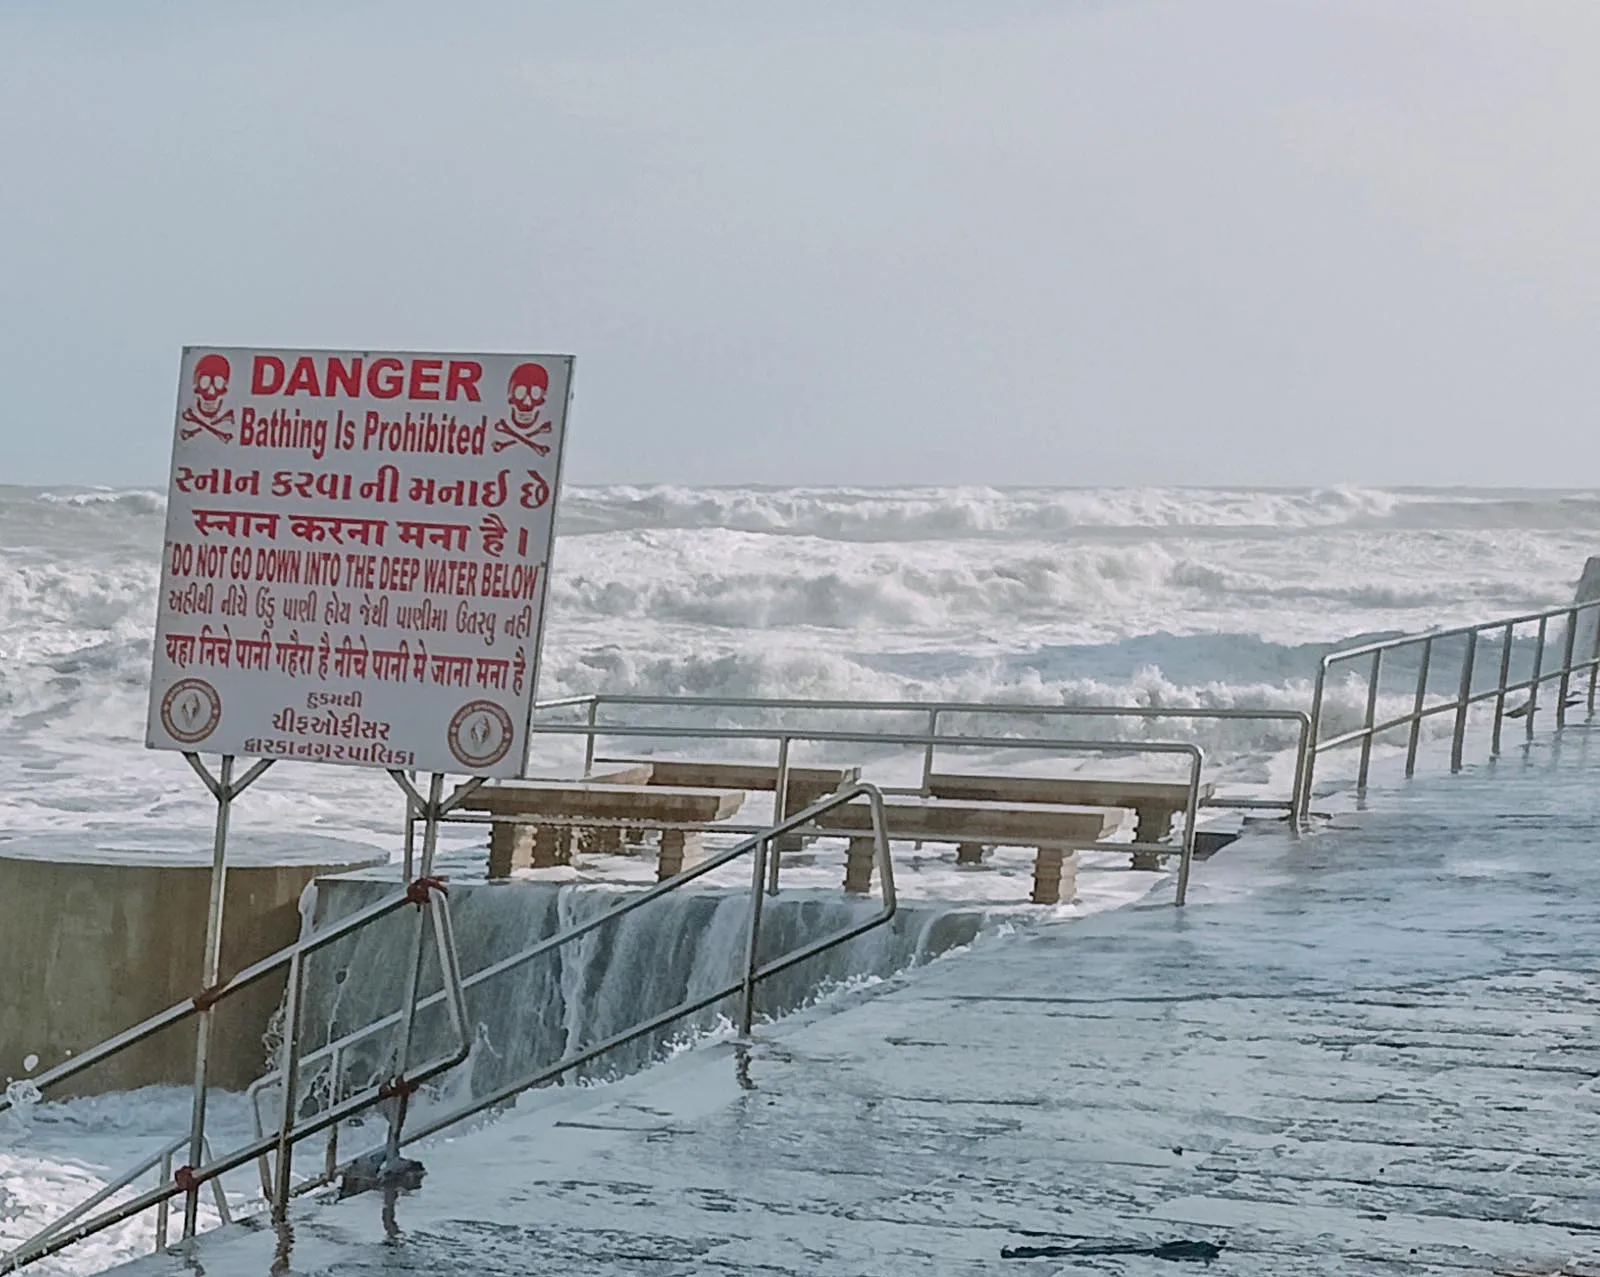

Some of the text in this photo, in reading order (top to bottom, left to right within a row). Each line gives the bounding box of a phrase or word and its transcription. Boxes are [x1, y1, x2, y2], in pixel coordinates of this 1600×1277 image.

[250, 354, 483, 403] DANGER
[239, 406, 488, 461] Bathing Is Prohibited
[408, 468, 511, 508] મનાઈ
[519, 469, 551, 510] છે
[191, 509, 282, 541] स्नान
[287, 514, 390, 547] करना
[395, 520, 472, 553] मना
[171, 543, 539, 601] DO NOT GO DOWN INTO THE DEEP WATER BELOW
[282, 590, 318, 623] પાણી
[324, 590, 352, 626] હોય
[359, 593, 389, 628] જેથી
[164, 633, 197, 669] यहा
[198, 623, 233, 669] निचे
[235, 628, 273, 672] पानी
[317, 631, 331, 682] है
[334, 634, 370, 680] नीचे
[371, 639, 411, 683] पानी
[430, 654, 474, 688] जाना
[475, 657, 511, 690] मना
[512, 645, 527, 697] है
